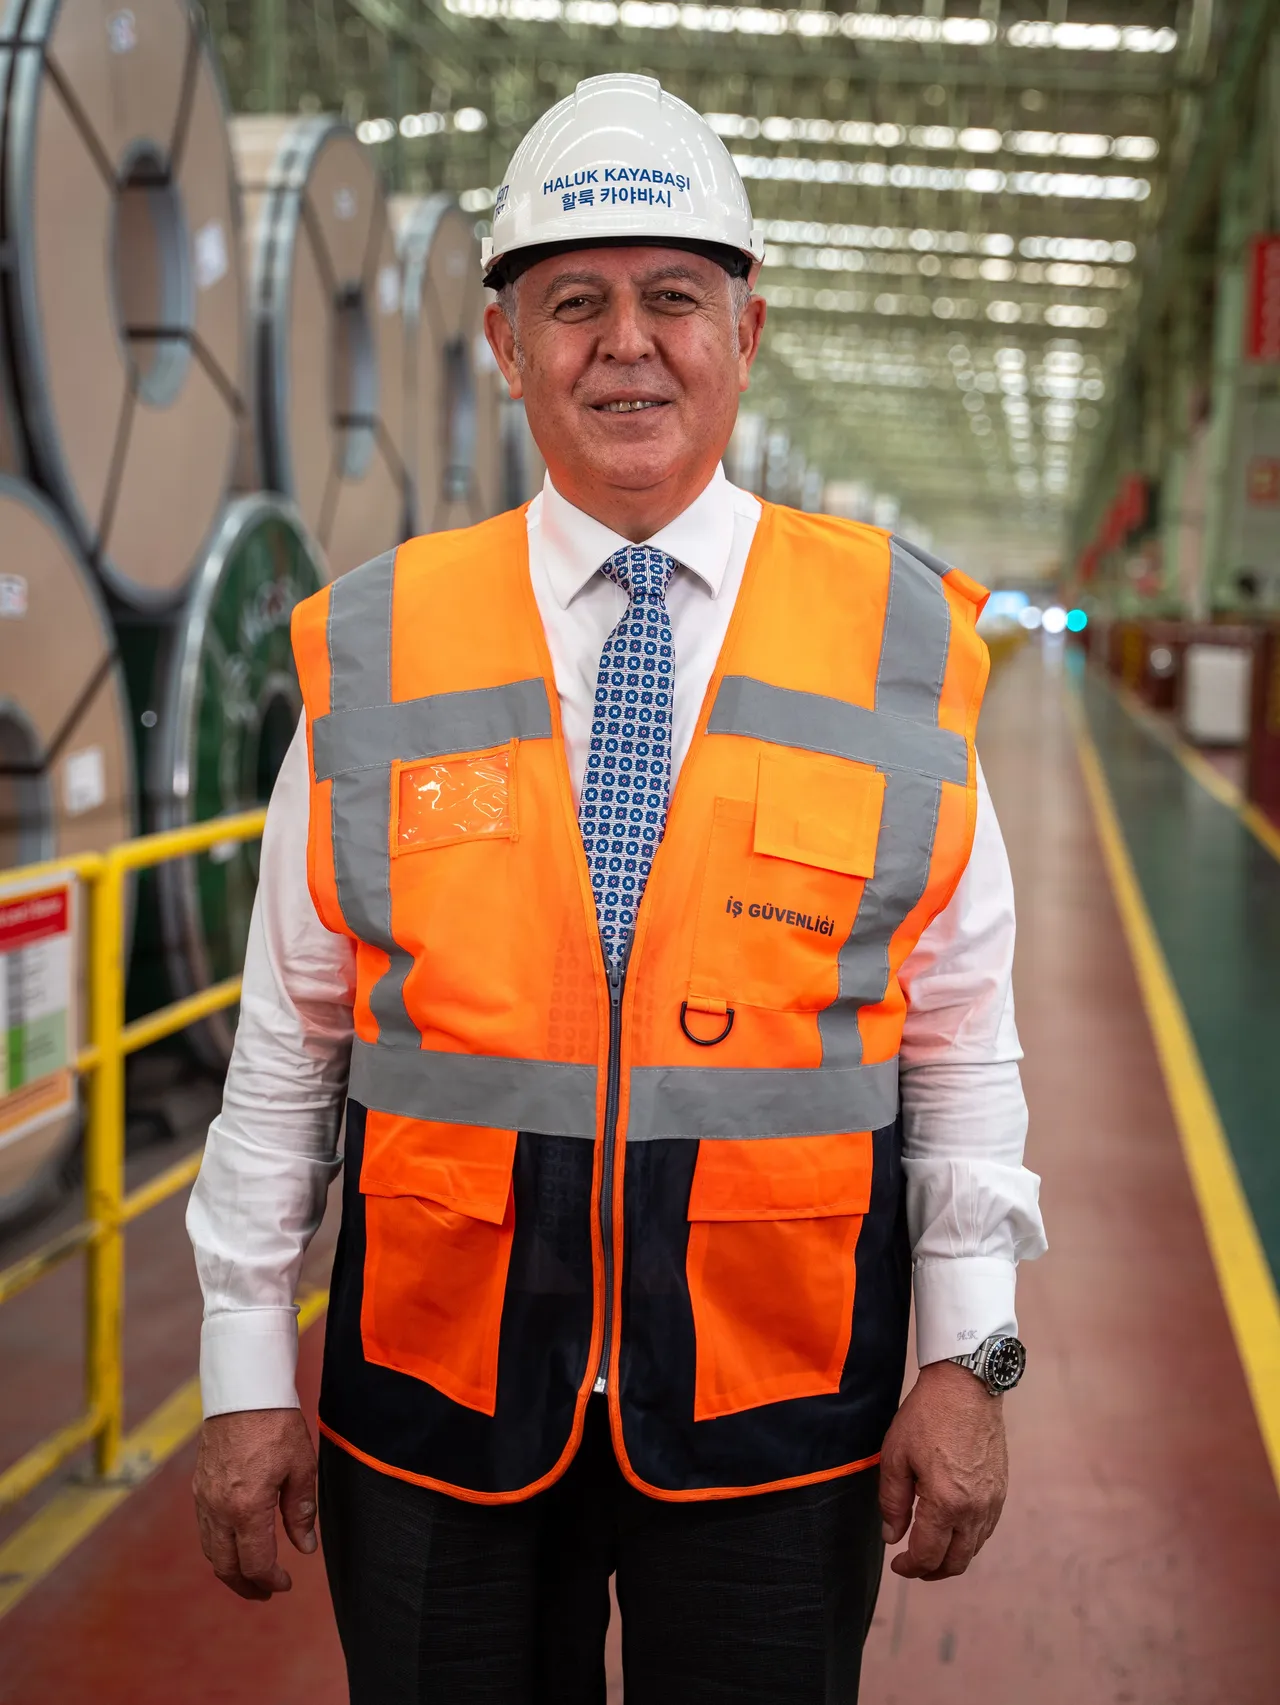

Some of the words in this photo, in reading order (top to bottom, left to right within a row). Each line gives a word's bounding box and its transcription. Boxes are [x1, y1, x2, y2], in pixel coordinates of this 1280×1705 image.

[543, 169, 599, 196] HALUK
[604, 168, 690, 192] KAYABAŞI
[561, 188, 595, 211] 할룩
[600, 186, 671, 208] 카야바시
[725, 895, 743, 918] İŞ
[748, 902, 835, 937] GÜVENLİĞİ
